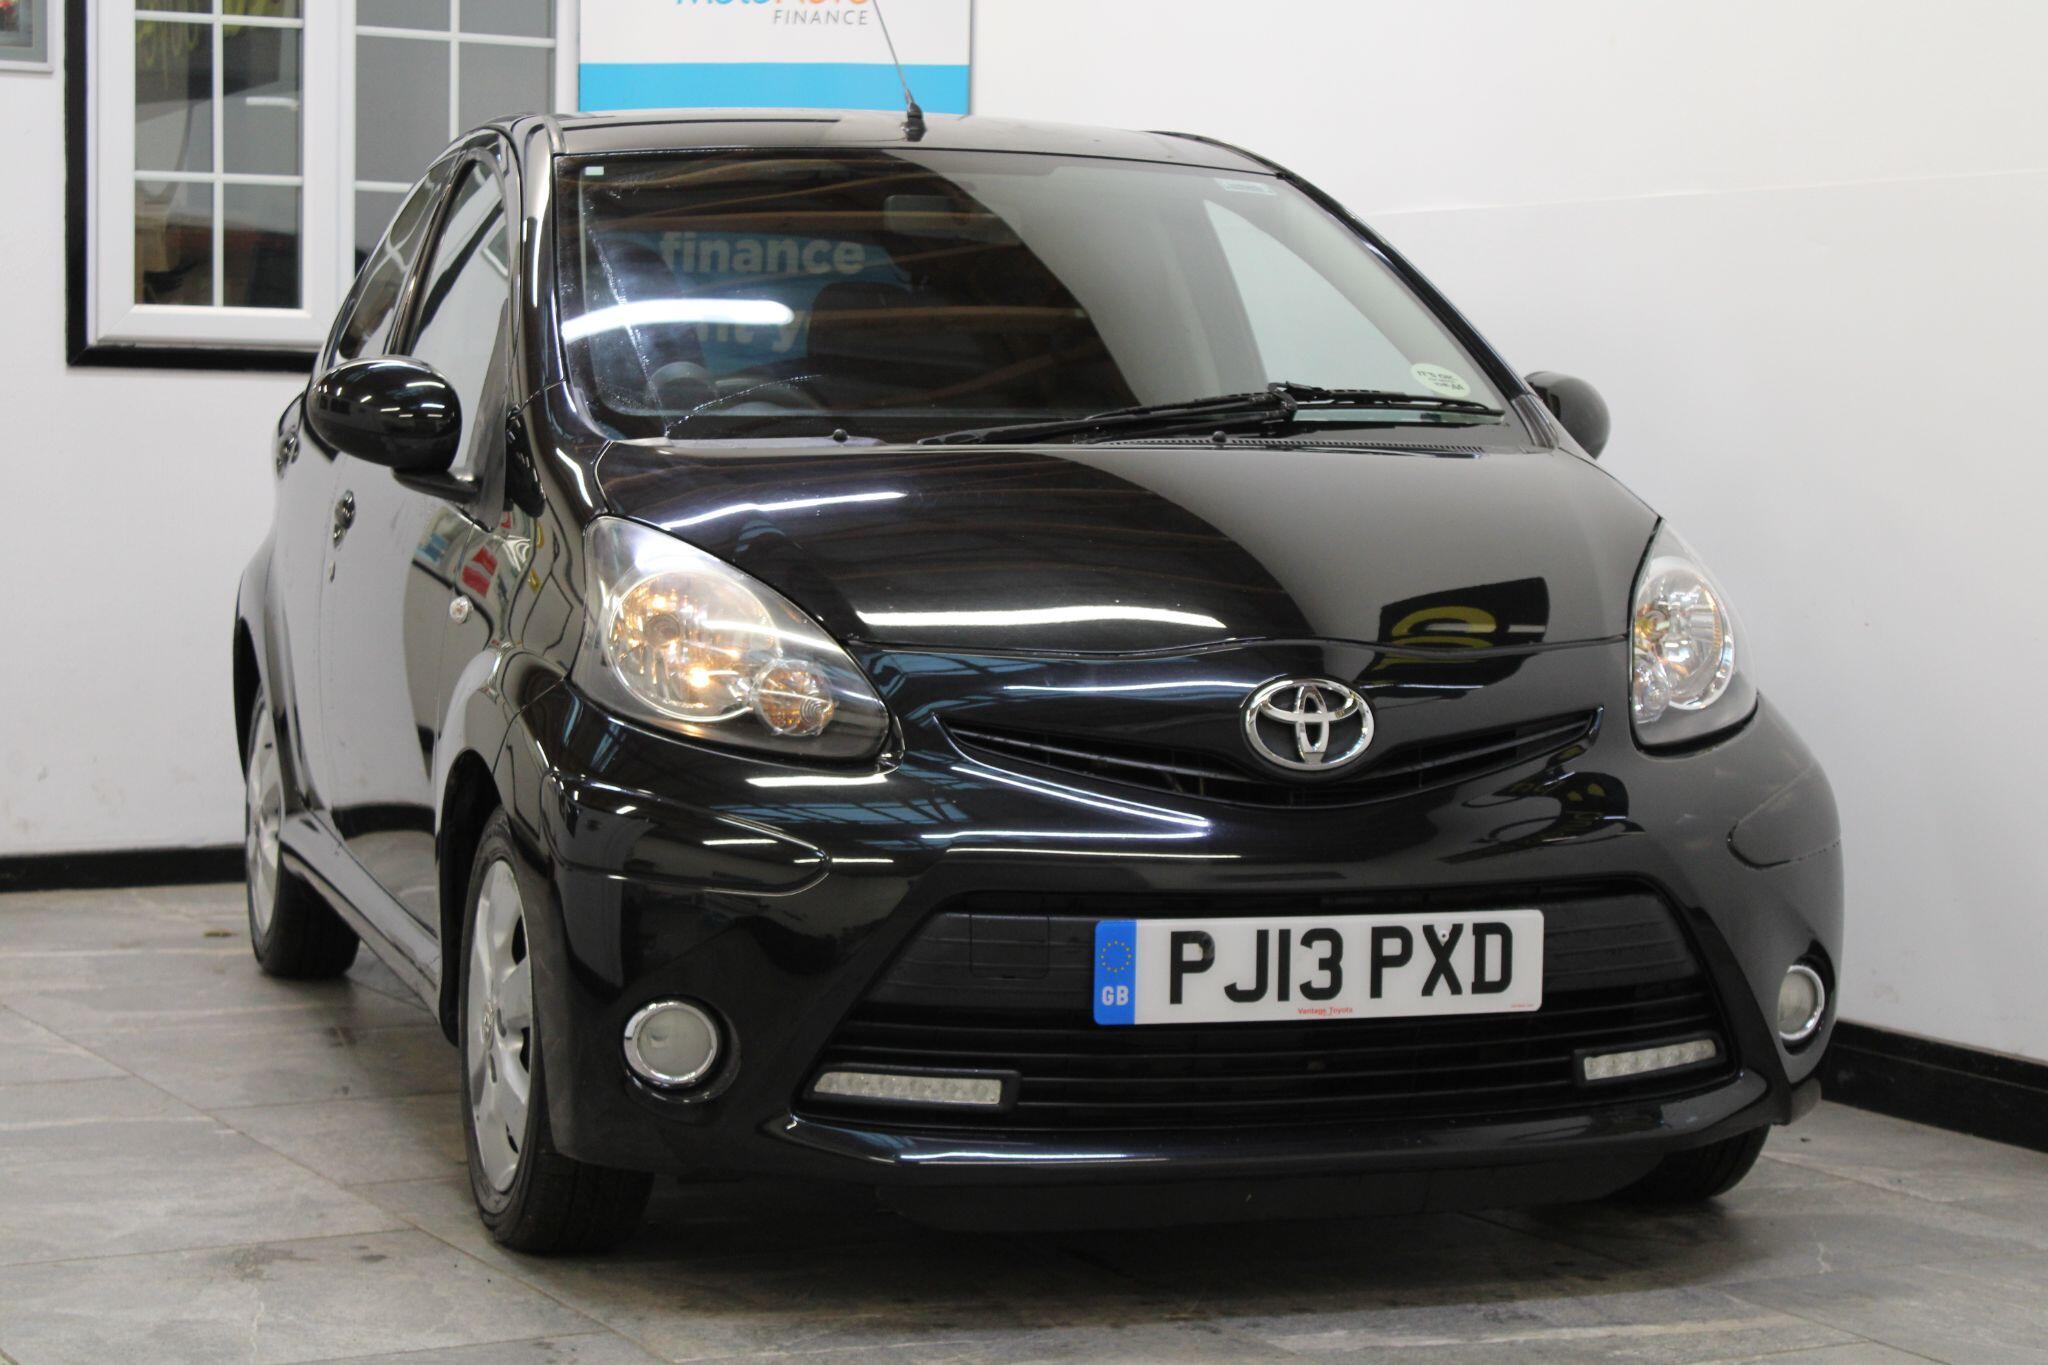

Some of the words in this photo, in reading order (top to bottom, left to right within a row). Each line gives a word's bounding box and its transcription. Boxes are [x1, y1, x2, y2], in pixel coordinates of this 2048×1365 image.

[773, 10, 868, 25] FINANCE
[660, 231, 866, 276] finance
[1169, 927, 1344, 1005] PJ13
[1370, 921, 1513, 999] PXD
[1102, 985, 1129, 1006] GB
